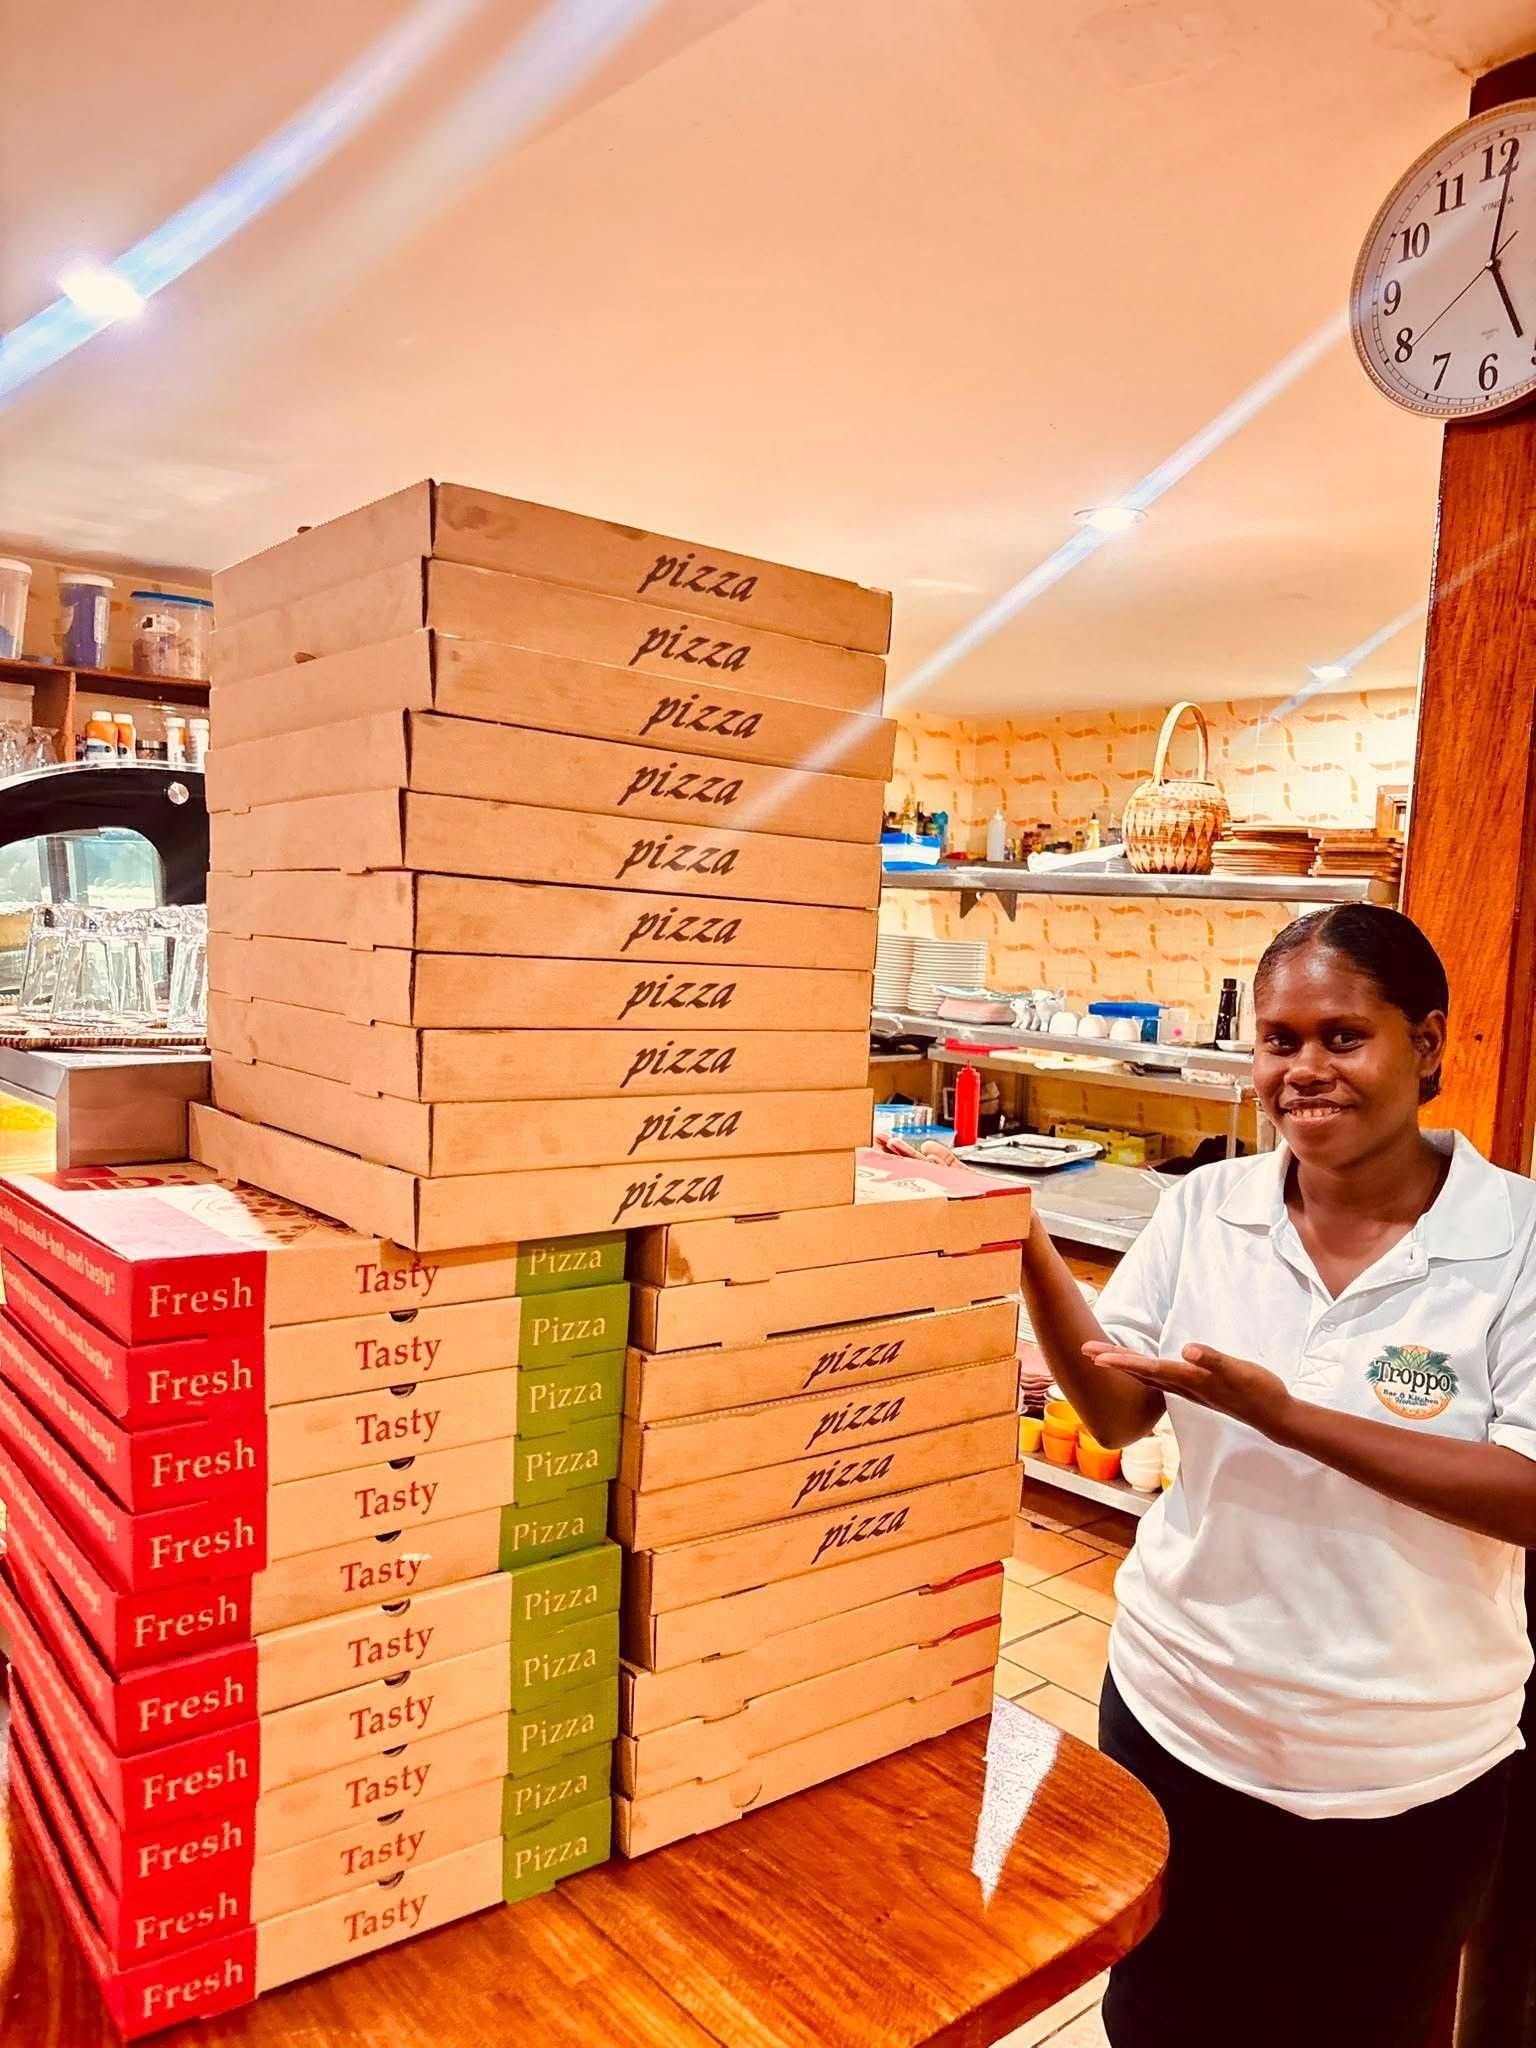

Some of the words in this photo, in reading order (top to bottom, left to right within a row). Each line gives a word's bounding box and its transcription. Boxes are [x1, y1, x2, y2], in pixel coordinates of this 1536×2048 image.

[1479, 137, 1520, 183] 12
[1434, 173, 1466, 217] 11
[1398, 222, 1430, 264] 10
[1383, 280, 1402, 317] 9
[1394, 327, 1414, 363] 8
[1432, 352, 1452, 391] 7
[1478, 353, 1499, 391] 6
[637, 553, 759, 602] pizza
[628, 625, 751, 672] pizza
[639, 694, 763, 739] pizza
[617, 762, 744, 806] pizza
[615, 834, 740, 880] pizza
[620, 907, 743, 952] pizza
[617, 974, 737, 1020] pizza
[620, 1040, 737, 1088] pizza
[627, 1106, 743, 1156] pizza
[611, 1173, 724, 1225] pizza
[149, 1277, 254, 1318] Fresh
[355, 1252, 440, 1297] Tasty
[529, 1247, 602, 1276] Pizza
[147, 1358, 254, 1404] Fresh
[355, 1336, 442, 1371] Tasty
[532, 1316, 607, 1346] Pizza
[802, 1339, 905, 1390] pizza
[1375, 1360, 1451, 1395] Troppo
[151, 1438, 257, 1488] Fresh
[356, 1408, 441, 1445] Tasty
[529, 1381, 603, 1414] Pizza
[805, 1397, 906, 1450] pizza
[792, 1454, 895, 1509] pizza
[150, 1517, 256, 1569] Fresh
[354, 1480, 439, 1519] Tasty
[526, 1448, 599, 1482] Pizza
[811, 1507, 910, 1565] pizza
[134, 1595, 238, 1649] Fresh
[340, 1555, 423, 1593] Tasty
[512, 1516, 585, 1551] Pizza
[139, 1676, 245, 1733] Fresh
[348, 1625, 434, 1669] Tasty
[523, 1585, 599, 1621] Pizza
[142, 1750, 248, 1811] Fresh
[349, 1695, 434, 1740] Tasty
[523, 1648, 597, 1687] Pizza
[138, 1820, 243, 1879] Fresh
[345, 1762, 432, 1809] Tasty
[520, 1713, 595, 1754] Pizza
[134, 1891, 239, 1949] Fresh
[340, 1829, 426, 1876] Tasty
[514, 1773, 589, 1816] Pizza
[142, 1958, 244, 2019] Fresh
[344, 1893, 428, 1943] Tasty
[514, 1834, 589, 1880] Pizza
